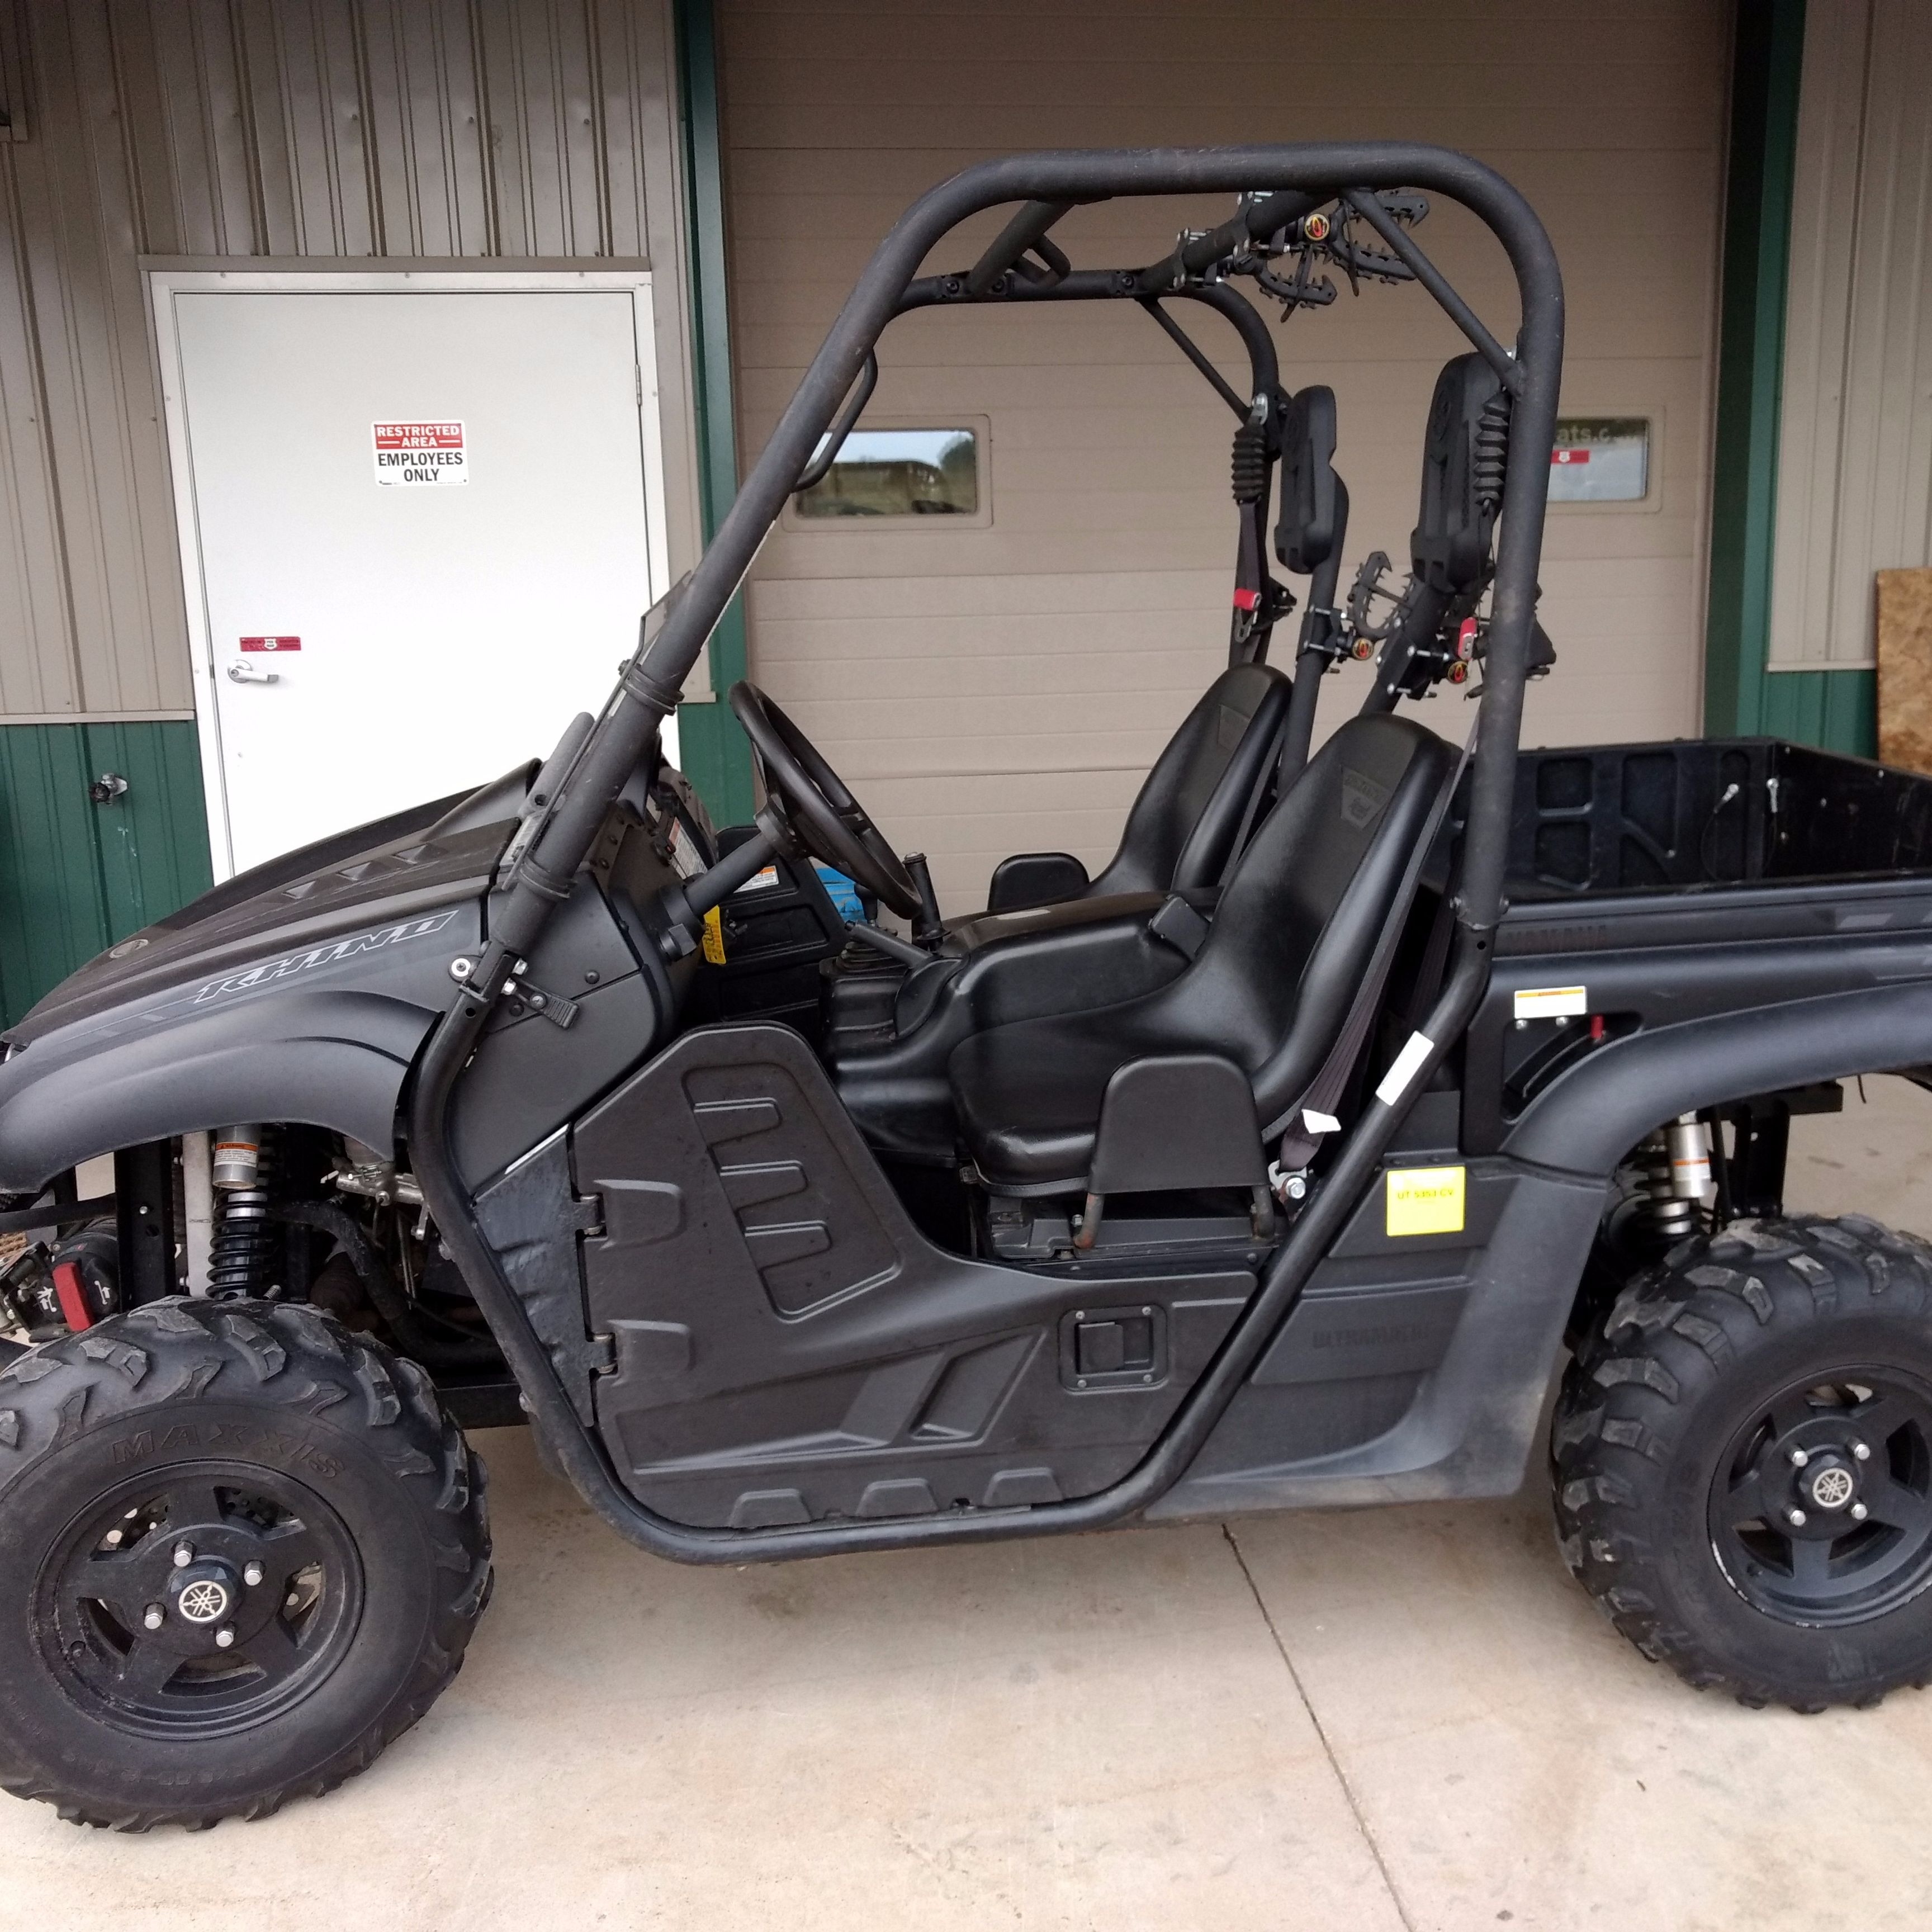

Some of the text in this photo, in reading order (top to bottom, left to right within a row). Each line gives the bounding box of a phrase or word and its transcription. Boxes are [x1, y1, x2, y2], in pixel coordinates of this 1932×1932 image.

[377, 425, 460, 437] RESTRICTED
[401, 437, 438, 447] AREA
[378, 452, 463, 466] EMPLOYEES
[404, 468, 439, 482] ONLY
[194, 910, 459, 1004] RHINO
[112, 1423, 345, 1479] MAXXIS
